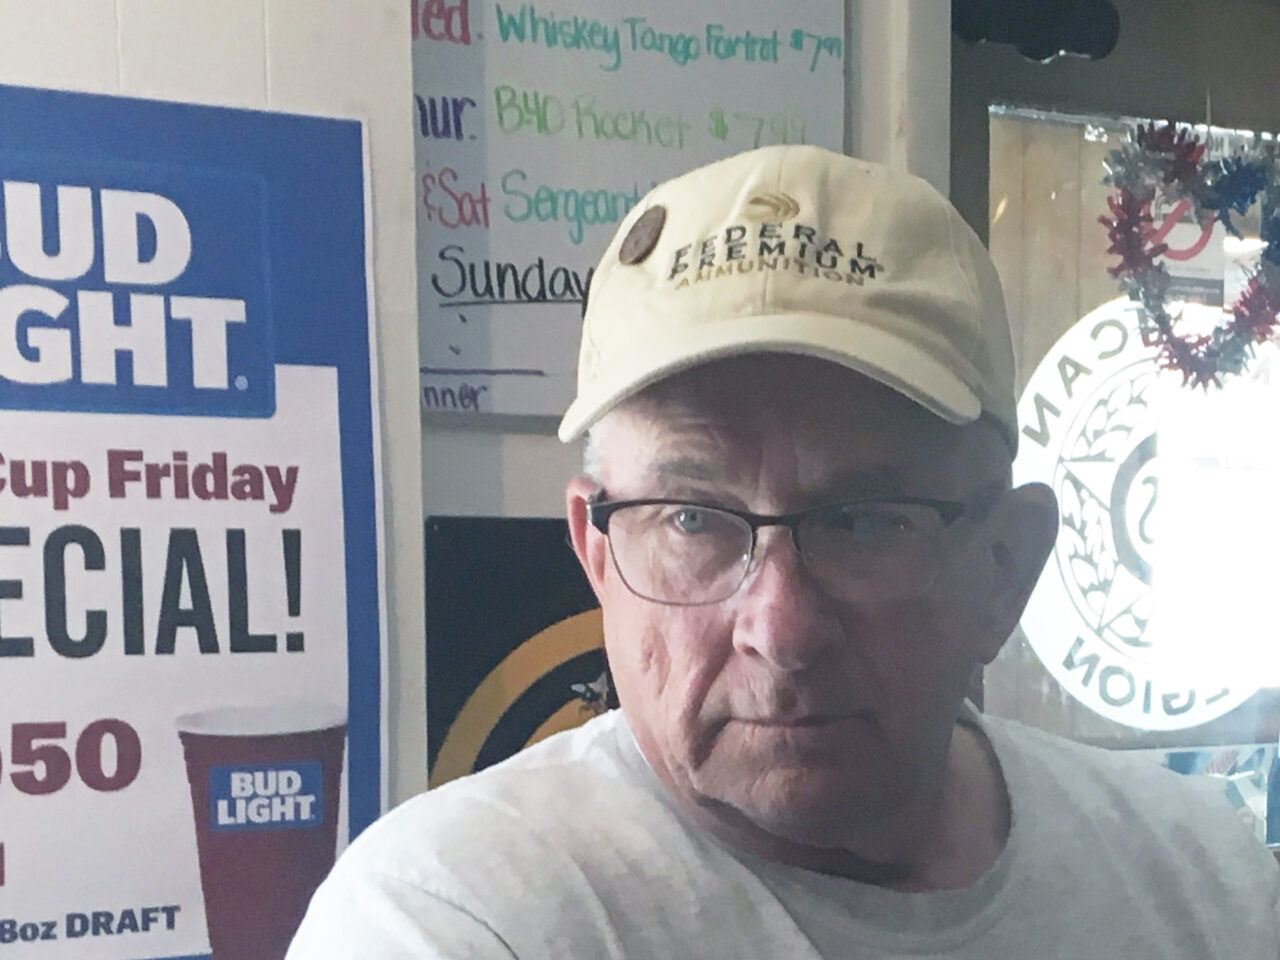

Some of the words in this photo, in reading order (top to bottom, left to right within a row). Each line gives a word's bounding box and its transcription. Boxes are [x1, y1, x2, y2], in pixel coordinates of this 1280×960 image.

[412, 0, 483, 44] ed.
[495, 3, 622, 72] Whiskey
[623, 17, 700, 67] Tango
[0, 180, 192, 285] UD
[673, 223, 877, 272] FEDERAL
[431, 244, 595, 320] Sunday
[667, 241, 877, 281] PREMIUM
[0, 452, 91, 511] up
[106, 449, 299, 514] Friday
[0, 718, 142, 795] 50
[231, 770, 302, 798] BUD
[217, 794, 315, 825] LIGHT
[65, 905, 181, 938] DRAFT
